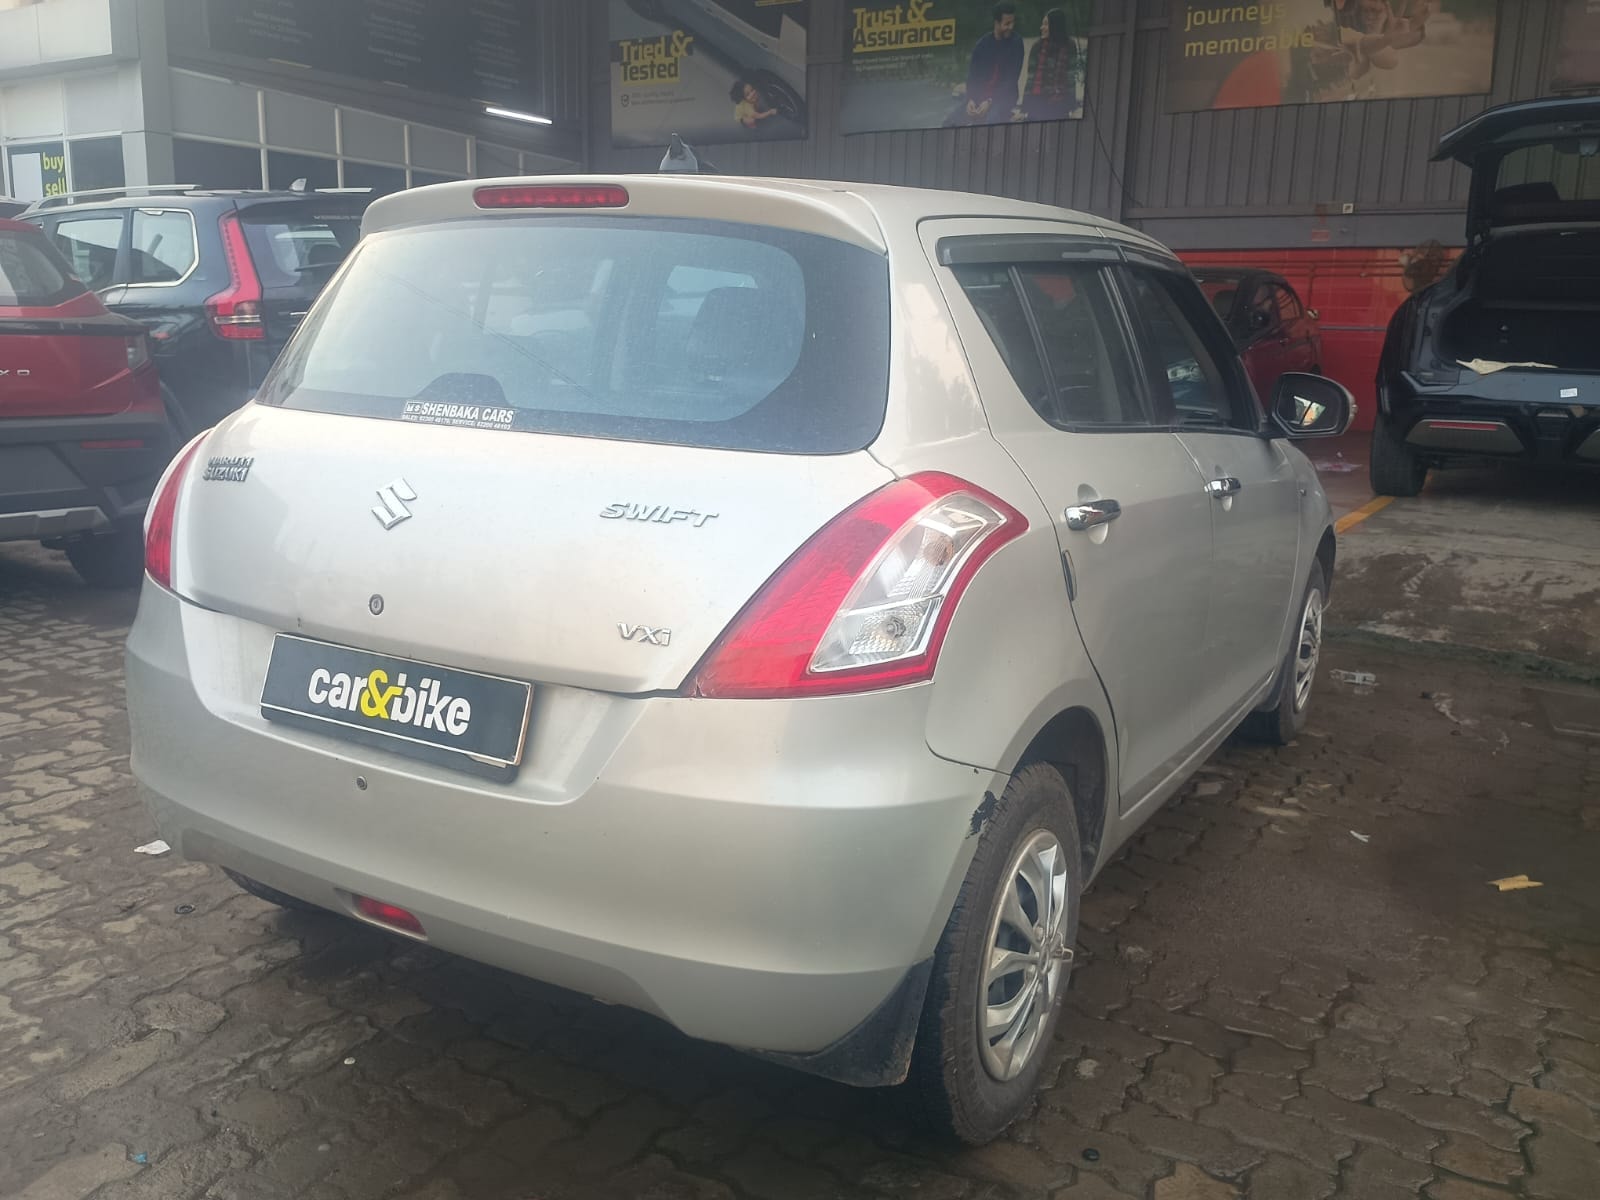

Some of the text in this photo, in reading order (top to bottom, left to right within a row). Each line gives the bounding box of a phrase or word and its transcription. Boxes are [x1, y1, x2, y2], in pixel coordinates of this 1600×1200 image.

[853, 4, 903, 29] Trust
[1184, 2, 1287, 32] journeys
[619, 29, 694, 63] Tried &
[854, 23, 953, 48] Assurance
[1184, 31, 1315, 57] memorable
[620, 57, 679, 82] Tested
[42, 151, 64, 173] buy
[45, 177, 67, 196] sell
[422, 402, 479, 420] SHENBAKA
[481, 407, 514, 424] CARS
[202, 466, 249, 482] SUZUKI
[600, 503, 720, 528] SWIFT
[617, 621, 671, 646] VXi
[308, 668, 471, 736] car&bike
